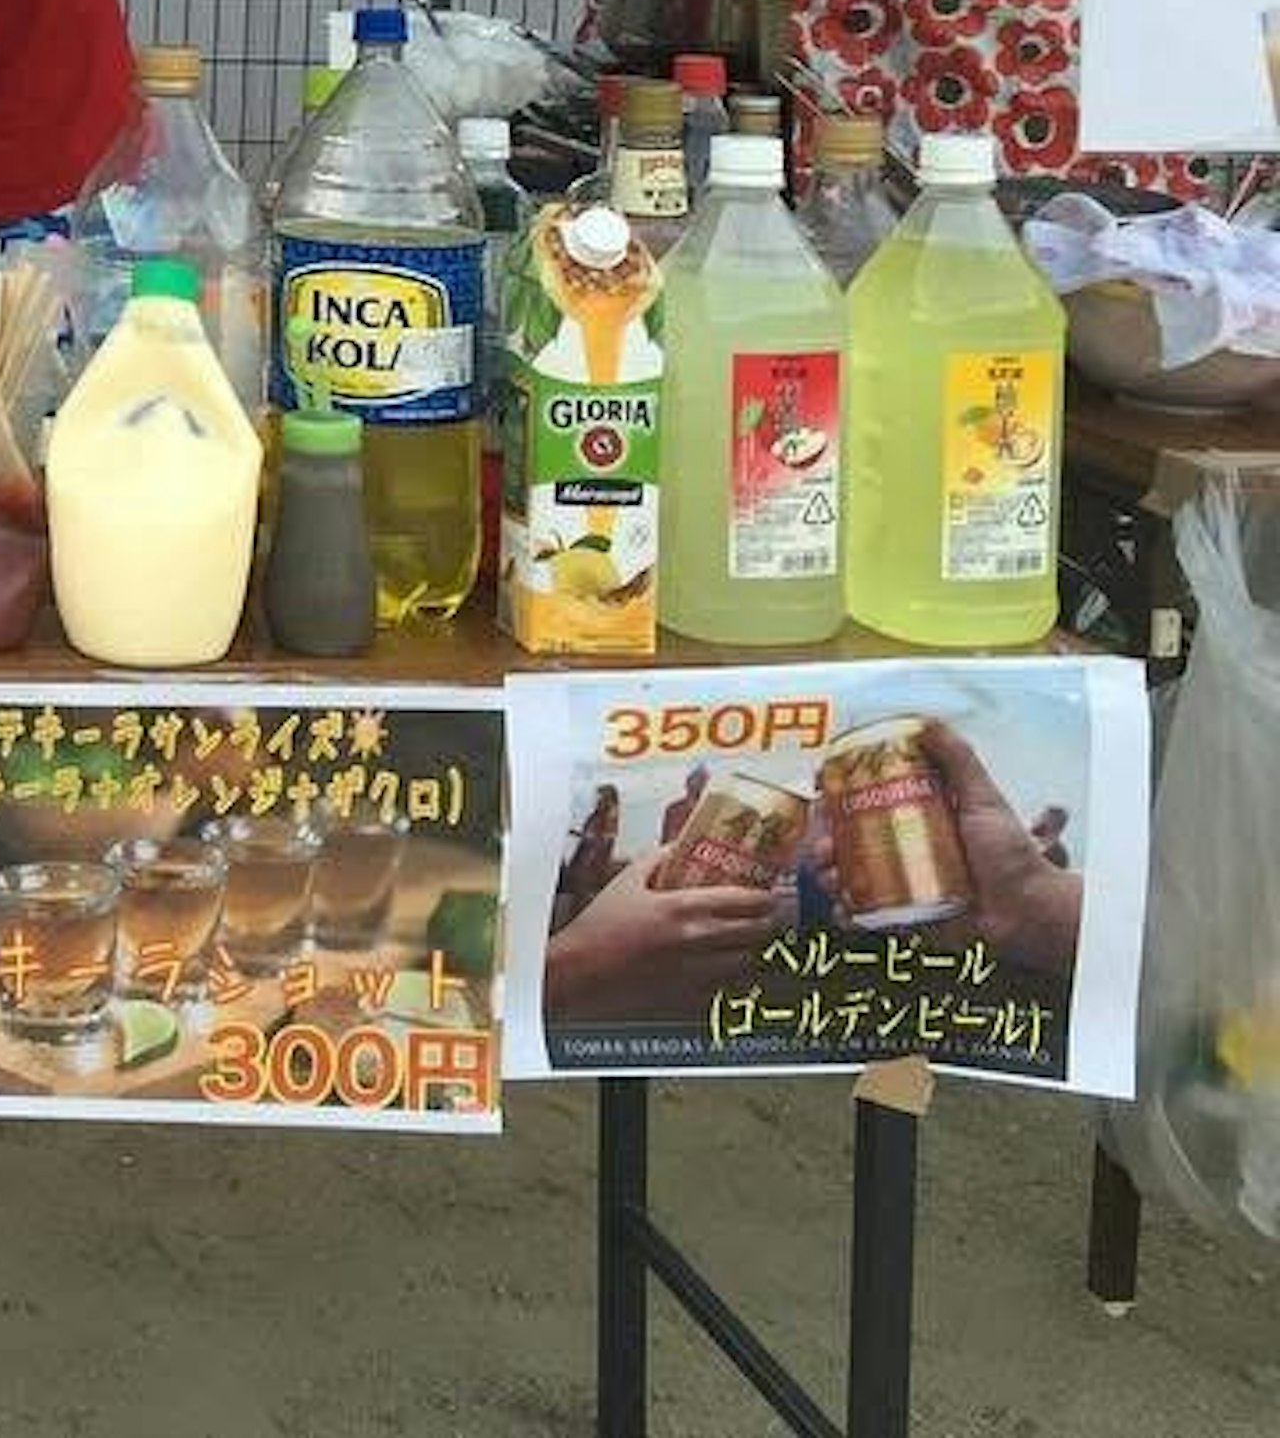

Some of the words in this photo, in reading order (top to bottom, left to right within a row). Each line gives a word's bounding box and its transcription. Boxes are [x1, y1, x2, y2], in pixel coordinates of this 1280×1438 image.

[310, 290, 410, 328] INCA
[550, 399, 651, 430] GLORIA
[602, 700, 830, 758] 350円
[760, 932, 998, 988] ペルービール
[708, 992, 1044, 1060] (ゴールデンビール)
[198, 1020, 496, 1116] 300円
